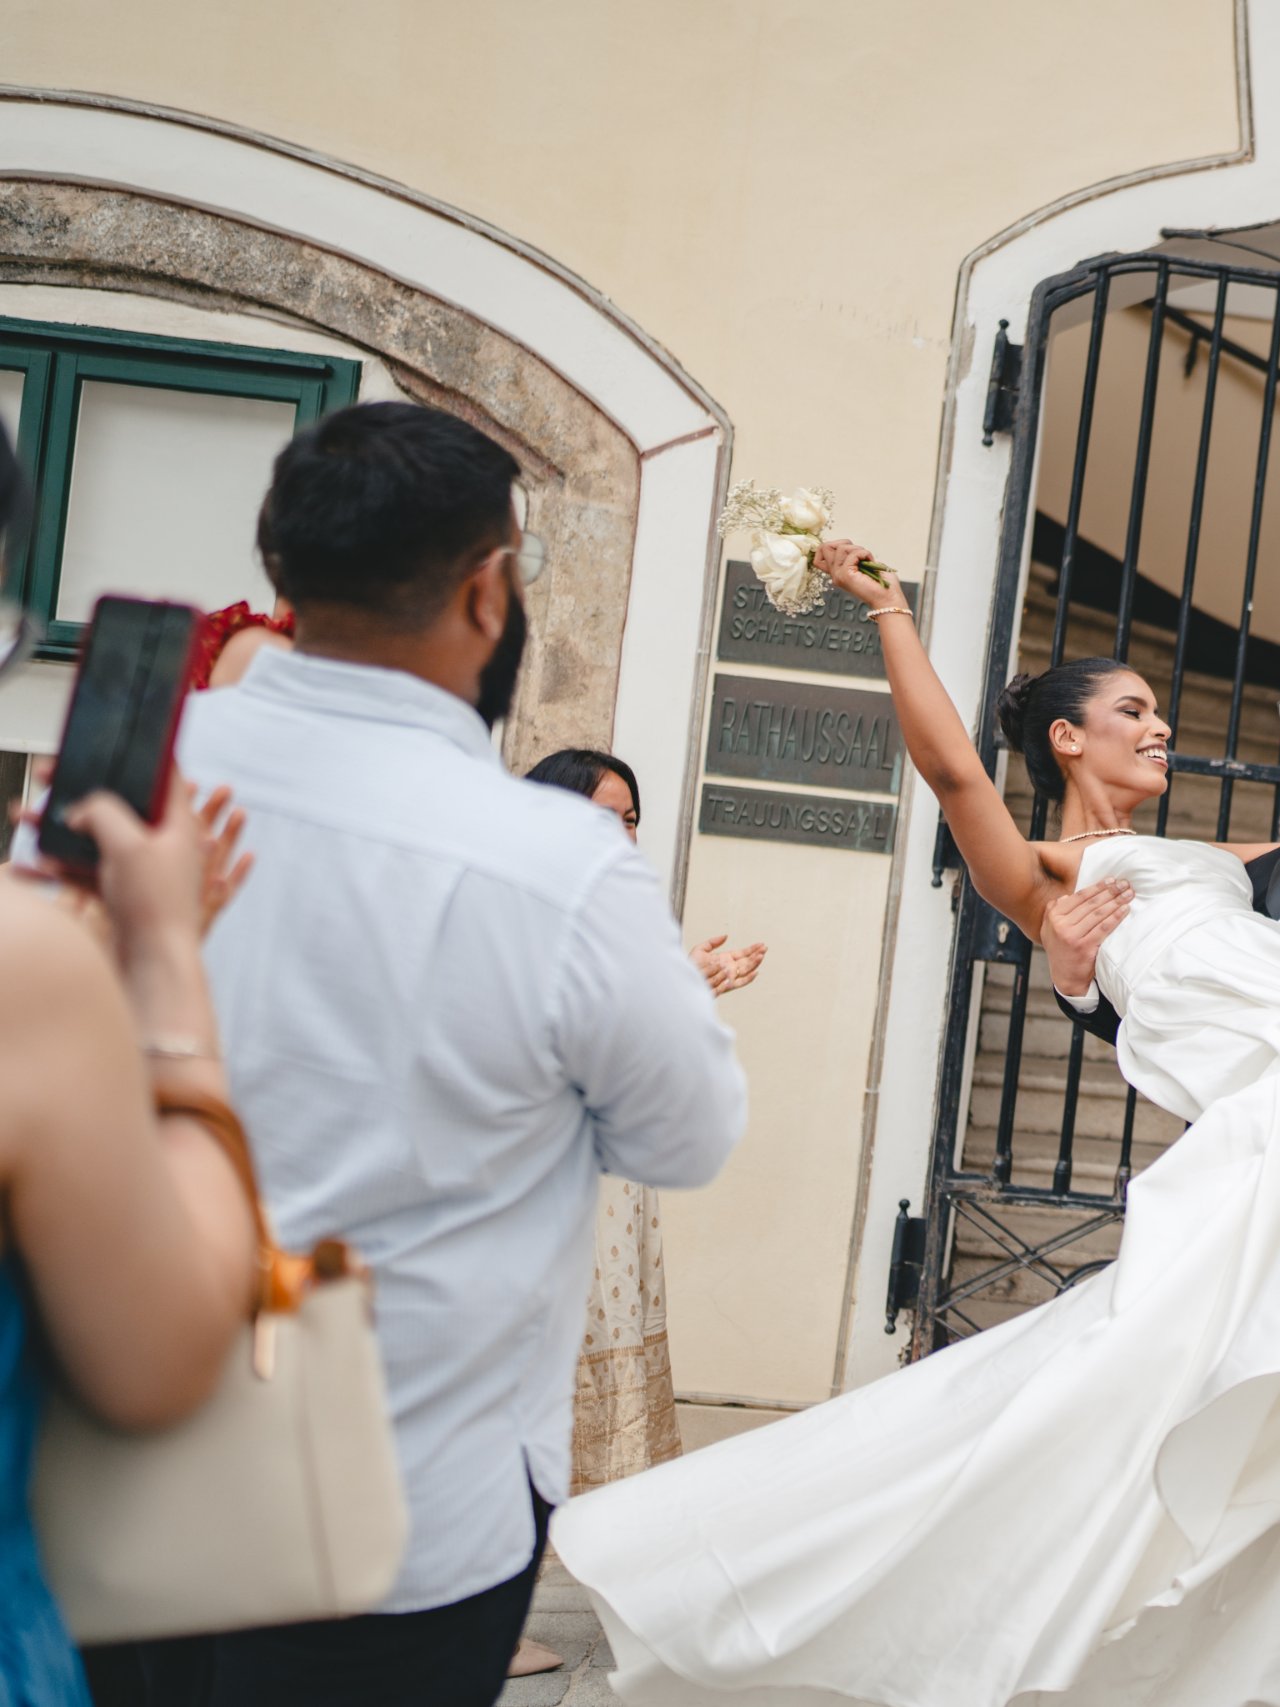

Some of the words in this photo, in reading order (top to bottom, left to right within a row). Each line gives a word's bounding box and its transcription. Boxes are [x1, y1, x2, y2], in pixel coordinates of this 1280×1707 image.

[730, 615, 881, 655] SCHAFTSVERBA
[717, 697, 893, 770] RATHAUSSAAL
[708, 795, 886, 840] TRAUUNGSSAAL
